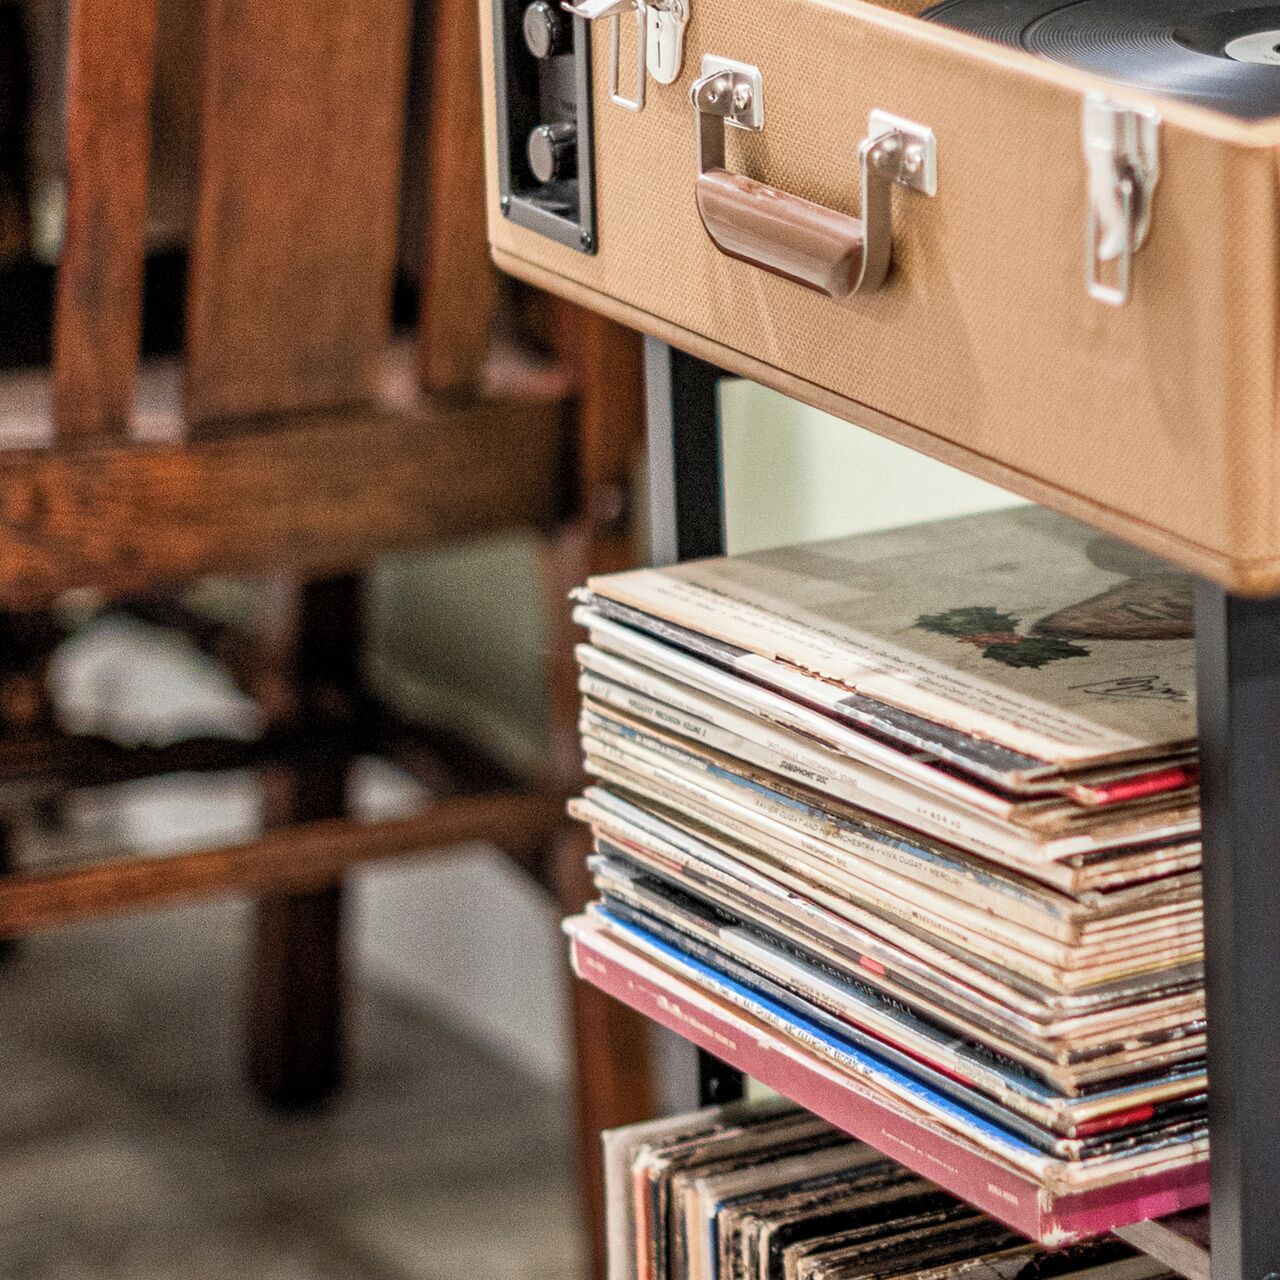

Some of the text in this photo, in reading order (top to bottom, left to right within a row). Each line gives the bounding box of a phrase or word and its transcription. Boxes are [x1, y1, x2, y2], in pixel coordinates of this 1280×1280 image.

[778, 807, 802, 825] CUGAT
[803, 818, 818, 832] AND
[831, 828, 875, 854] ORCHESTRA
[880, 847, 897, 862] VIVA
[898, 854, 922, 871] CUGAT
[811, 955, 876, 998] CARNEGIE
[881, 991, 916, 1019] HALL
